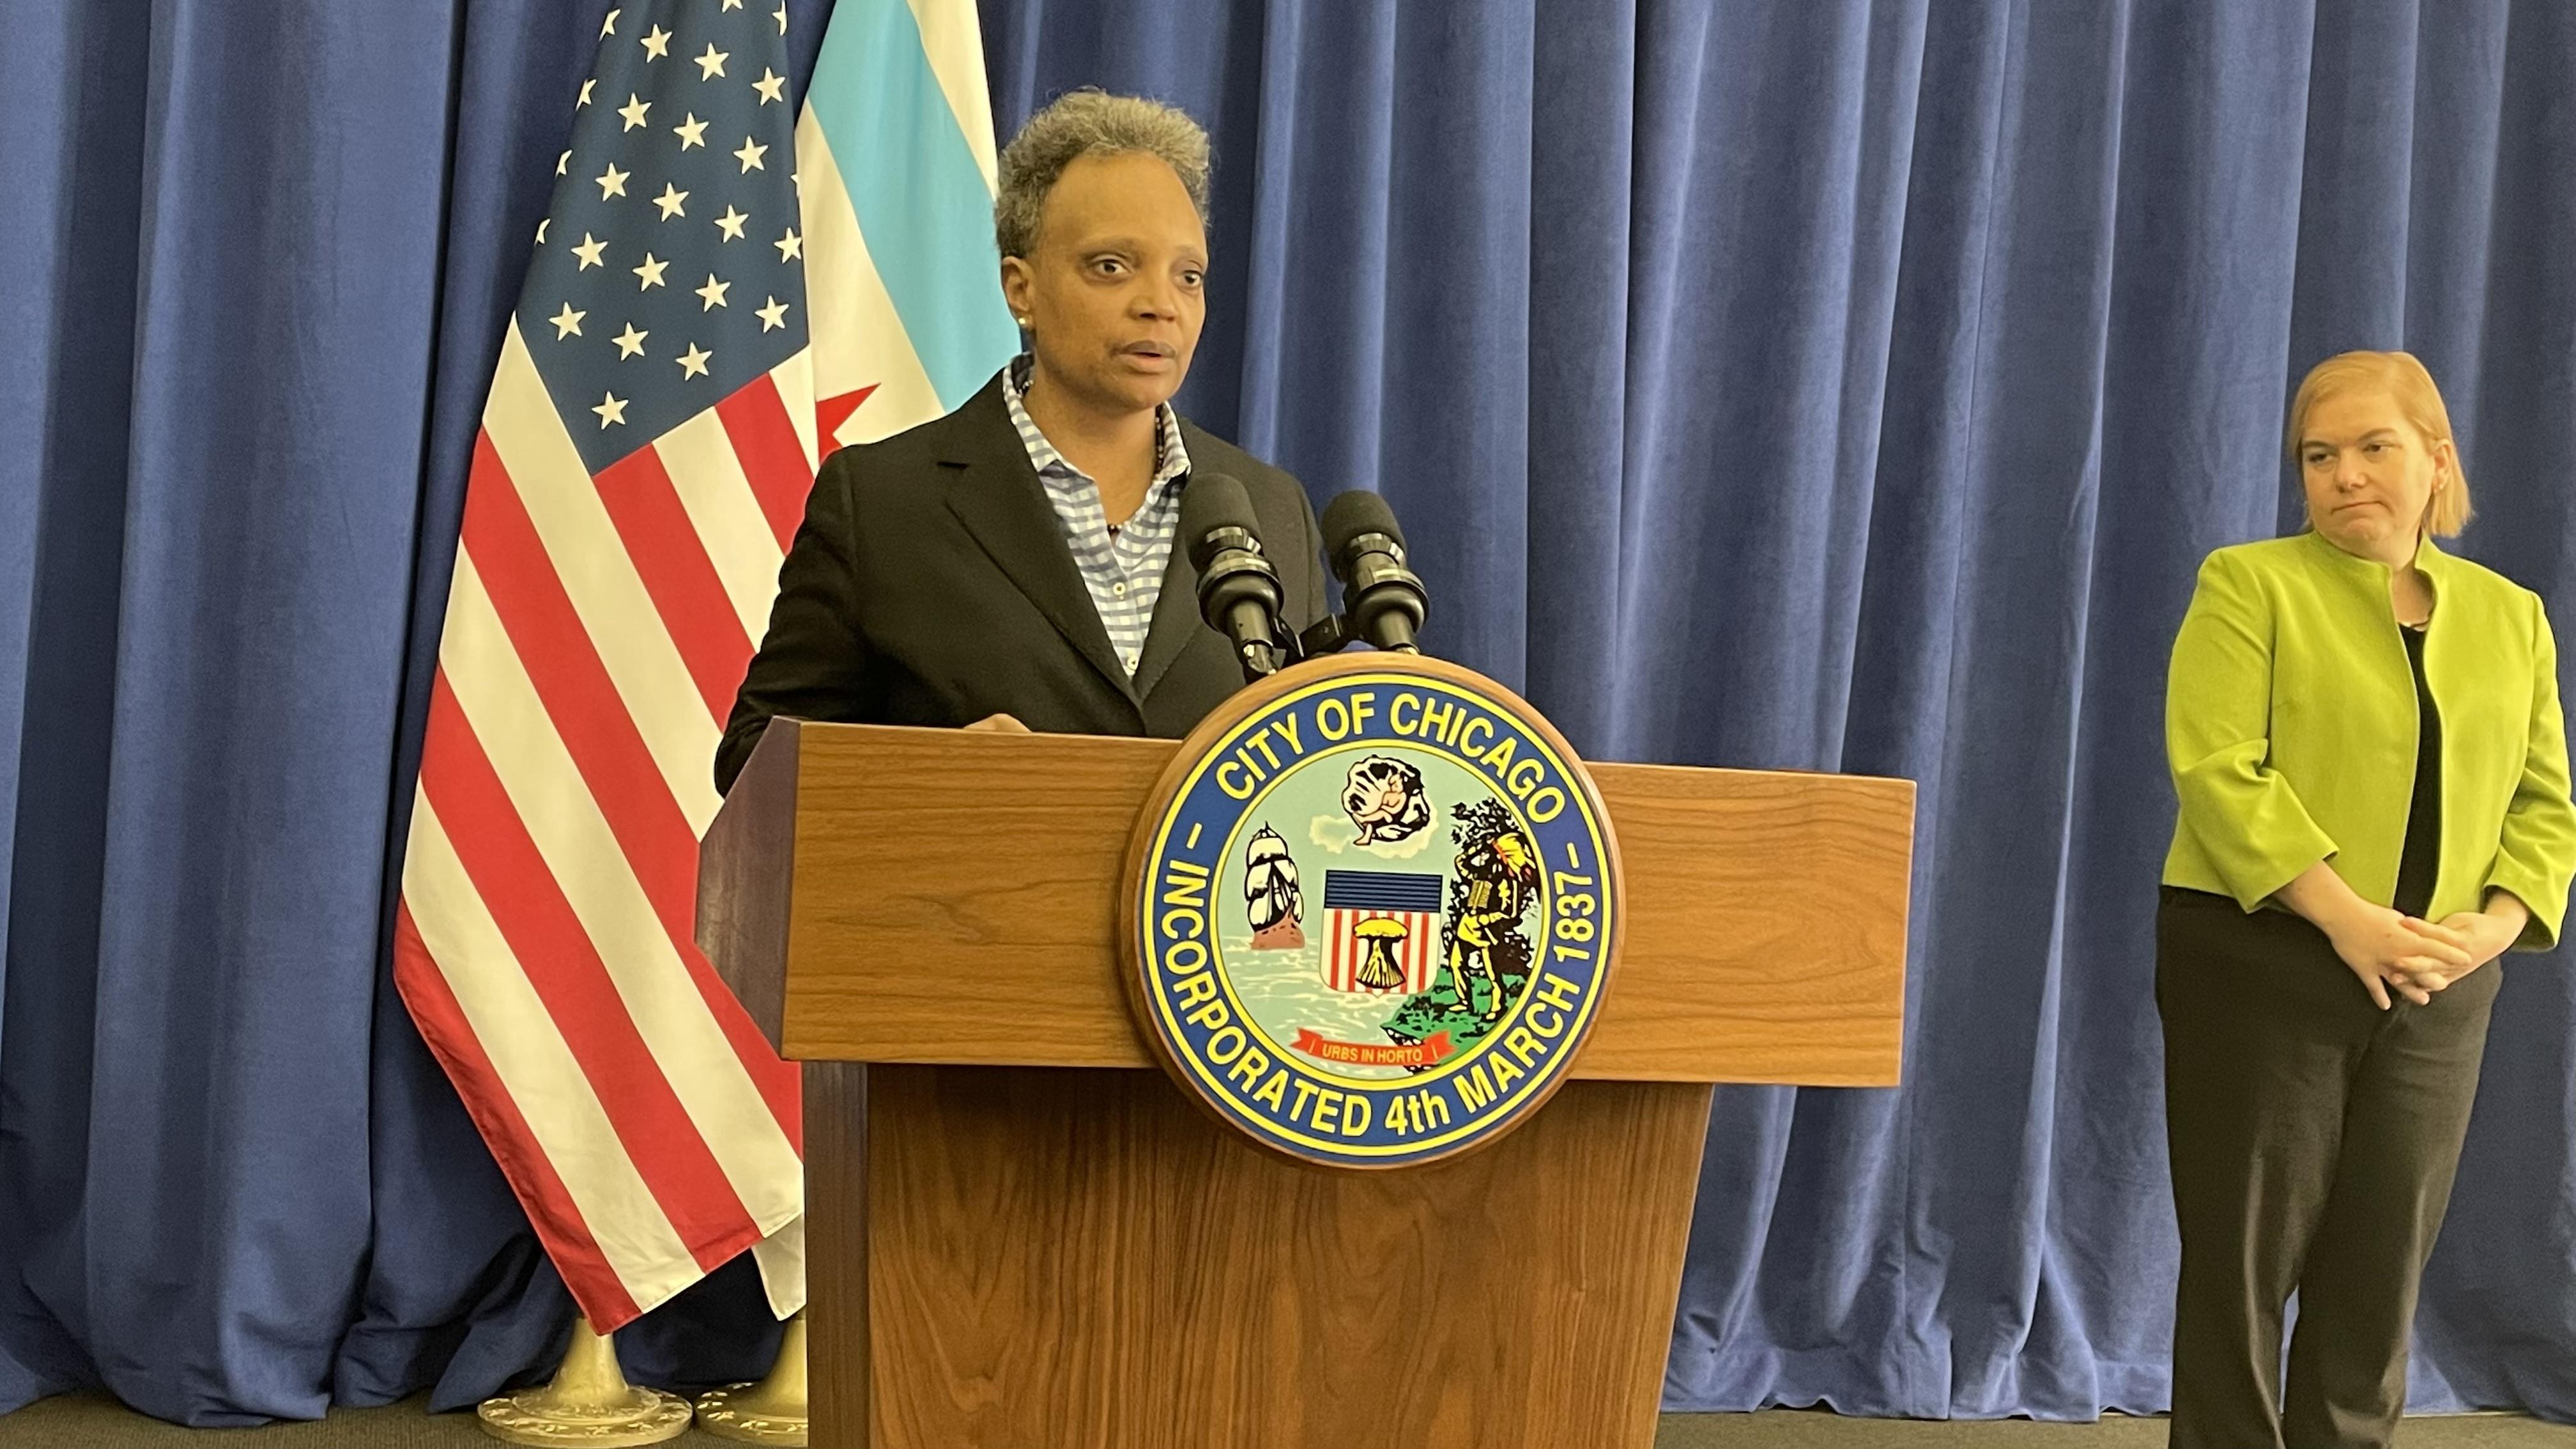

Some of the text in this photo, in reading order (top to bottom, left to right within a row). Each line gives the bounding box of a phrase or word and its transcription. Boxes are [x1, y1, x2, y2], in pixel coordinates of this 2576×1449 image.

[1215, 691, 1567, 824] CITY OF CHICAGO
[1161, 859, 1372, 1137] INCORPORATED
[1384, 1089, 1451, 1136] 4th
[1452, 972, 1581, 1114] MARCH
[1322, 1043, 1423, 1064] URBS IN HORTO
